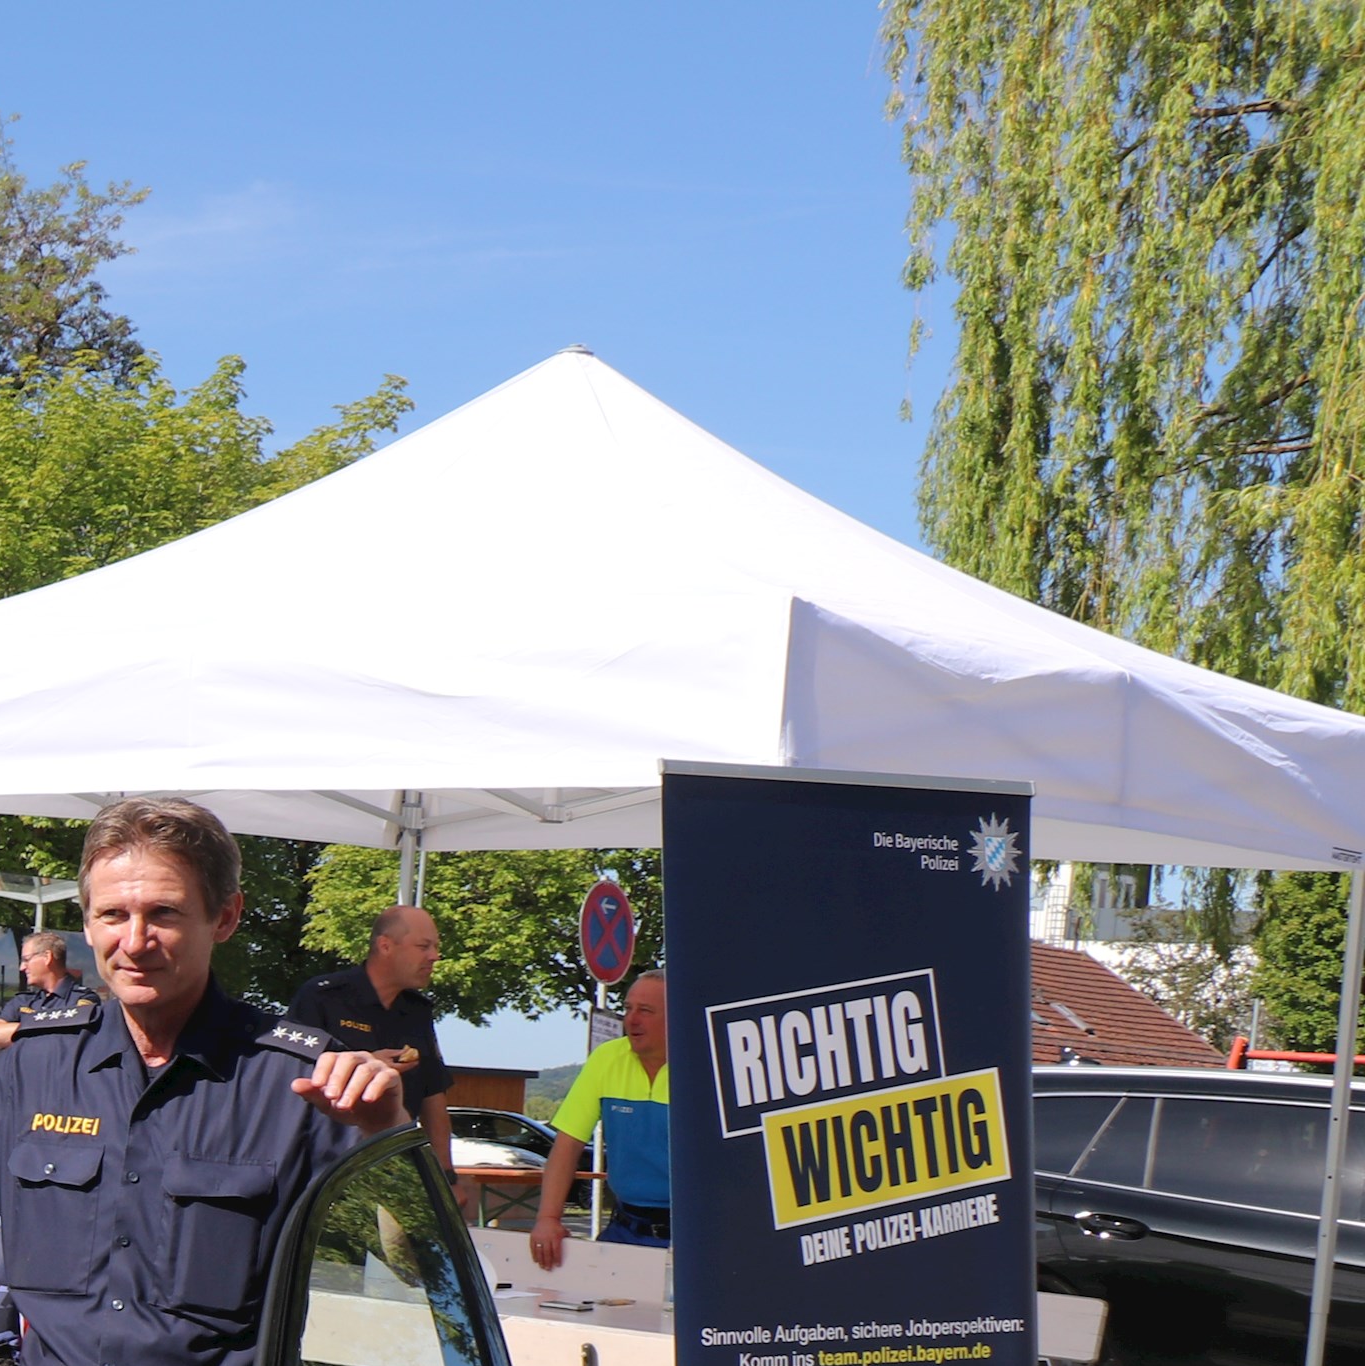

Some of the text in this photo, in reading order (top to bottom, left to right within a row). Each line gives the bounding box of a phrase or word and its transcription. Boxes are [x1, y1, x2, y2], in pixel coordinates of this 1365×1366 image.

[873, 832, 959, 852] Die Bayerische
[921, 855, 959, 871] Polizei
[727, 990, 929, 1107] RICHTIG
[31, 1113, 100, 1136] POLIZEI
[781, 1088, 992, 1208] WICHTIG
[800, 1193, 1000, 1266] DEINE POLIZEI-KARRIERE
[701, 1316, 1024, 1346] Sinnvolle Aufgaben, sichere Jobperspektiven:
